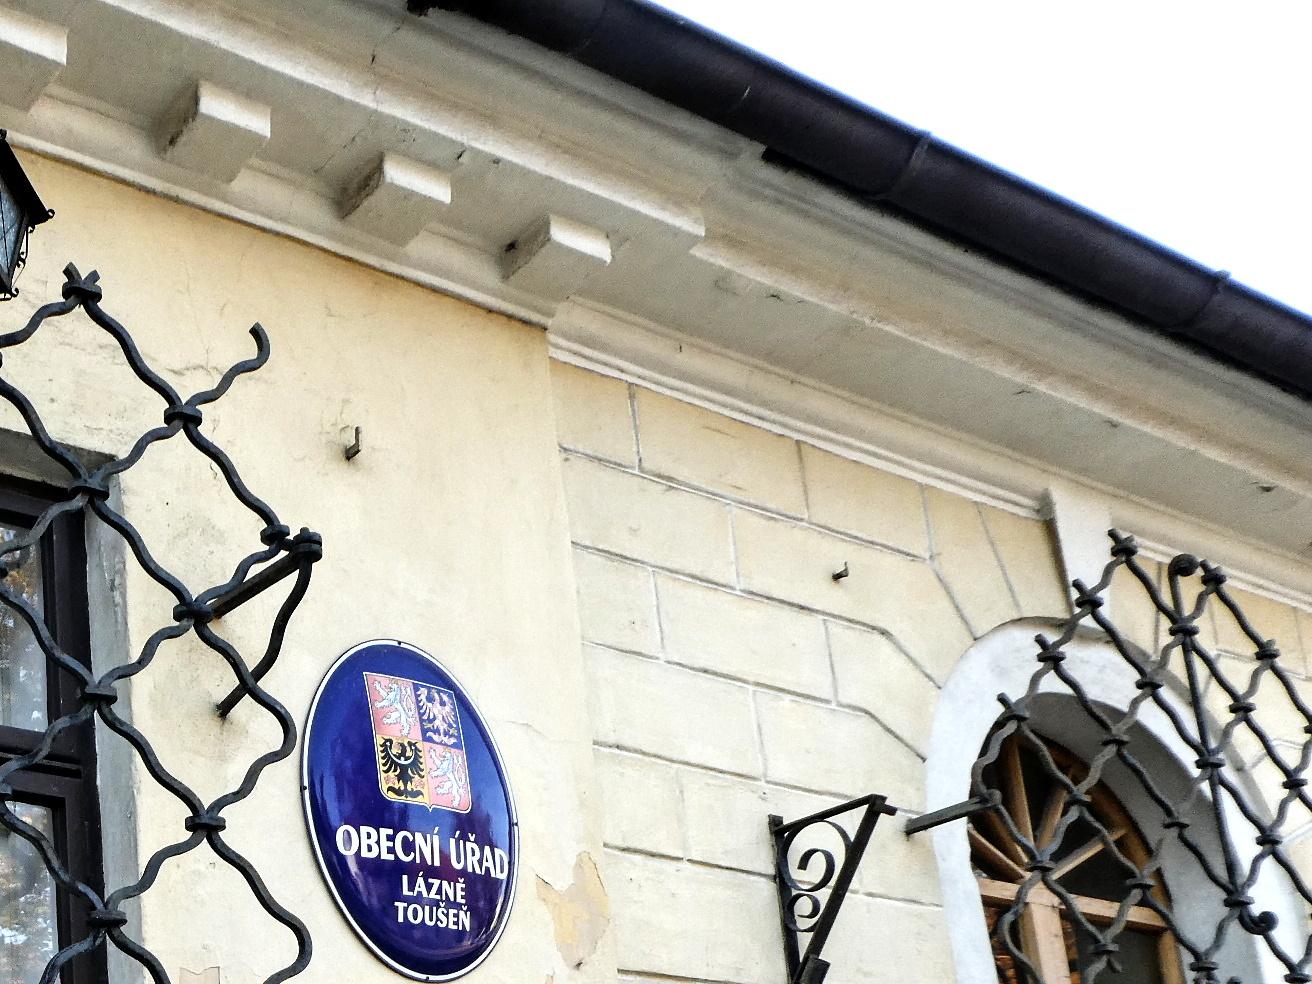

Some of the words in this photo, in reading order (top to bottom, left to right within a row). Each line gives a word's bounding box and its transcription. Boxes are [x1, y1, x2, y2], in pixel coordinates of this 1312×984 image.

[335, 824, 441, 867] OBECNÍ
[449, 830, 509, 880] ÚŘAD
[401, 871, 466, 904] LÁZNĚ
[394, 901, 471, 932] TOUŠEŇ
